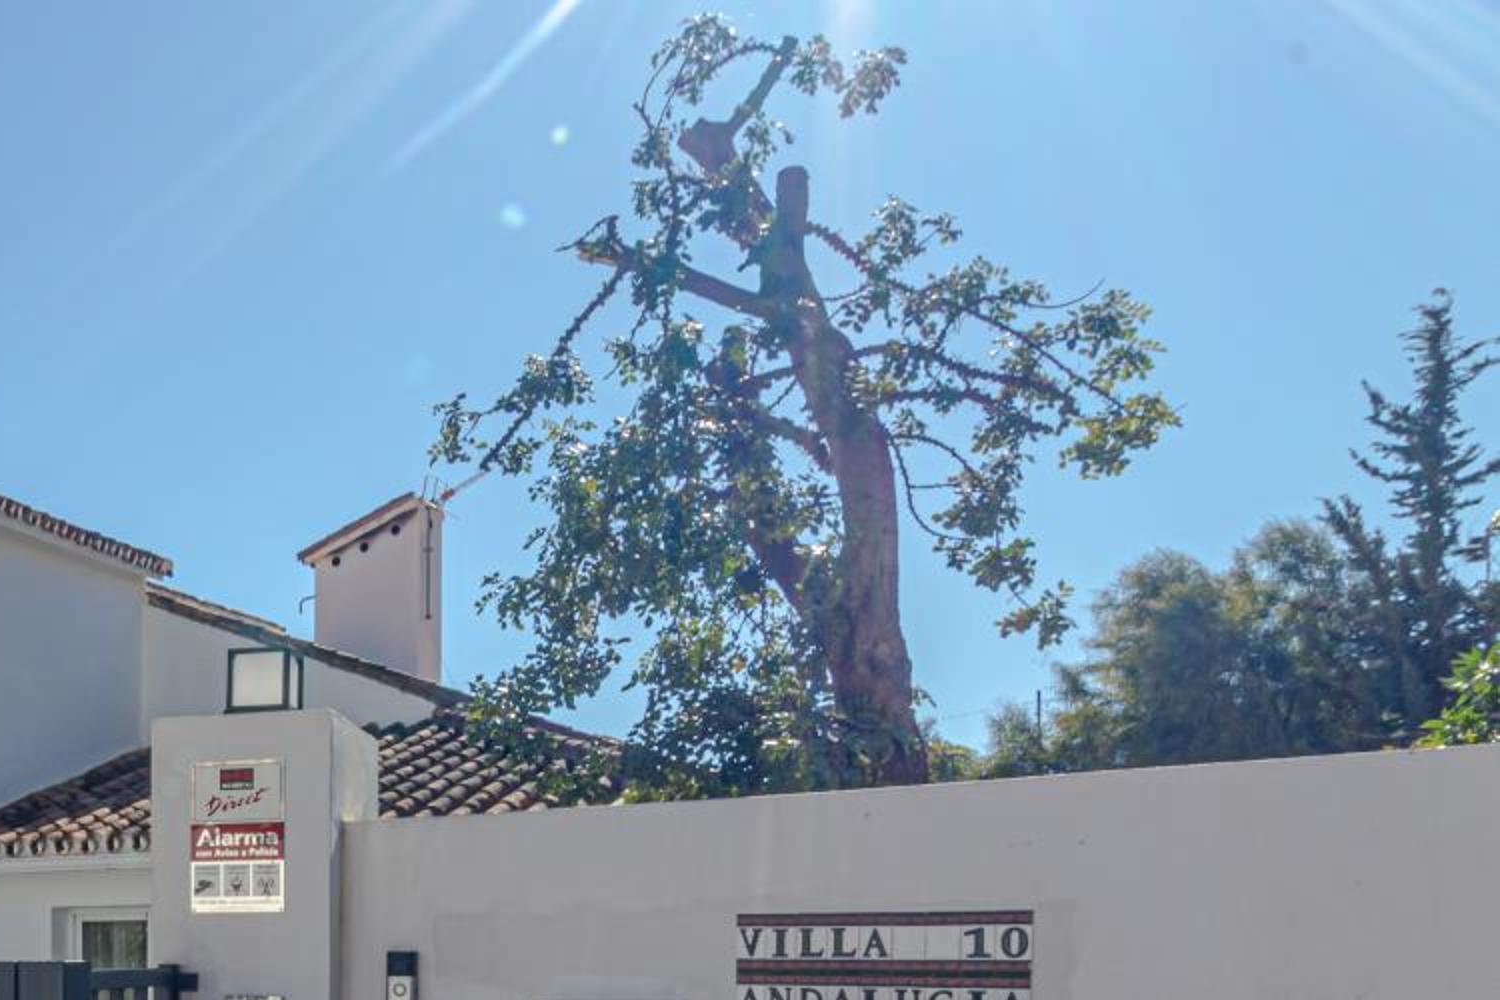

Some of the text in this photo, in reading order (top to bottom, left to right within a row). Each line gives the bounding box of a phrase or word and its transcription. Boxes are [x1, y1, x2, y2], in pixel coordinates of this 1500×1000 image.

[196, 827, 279, 848] Alarma
[740, 926, 1030, 959] VILLA 10
